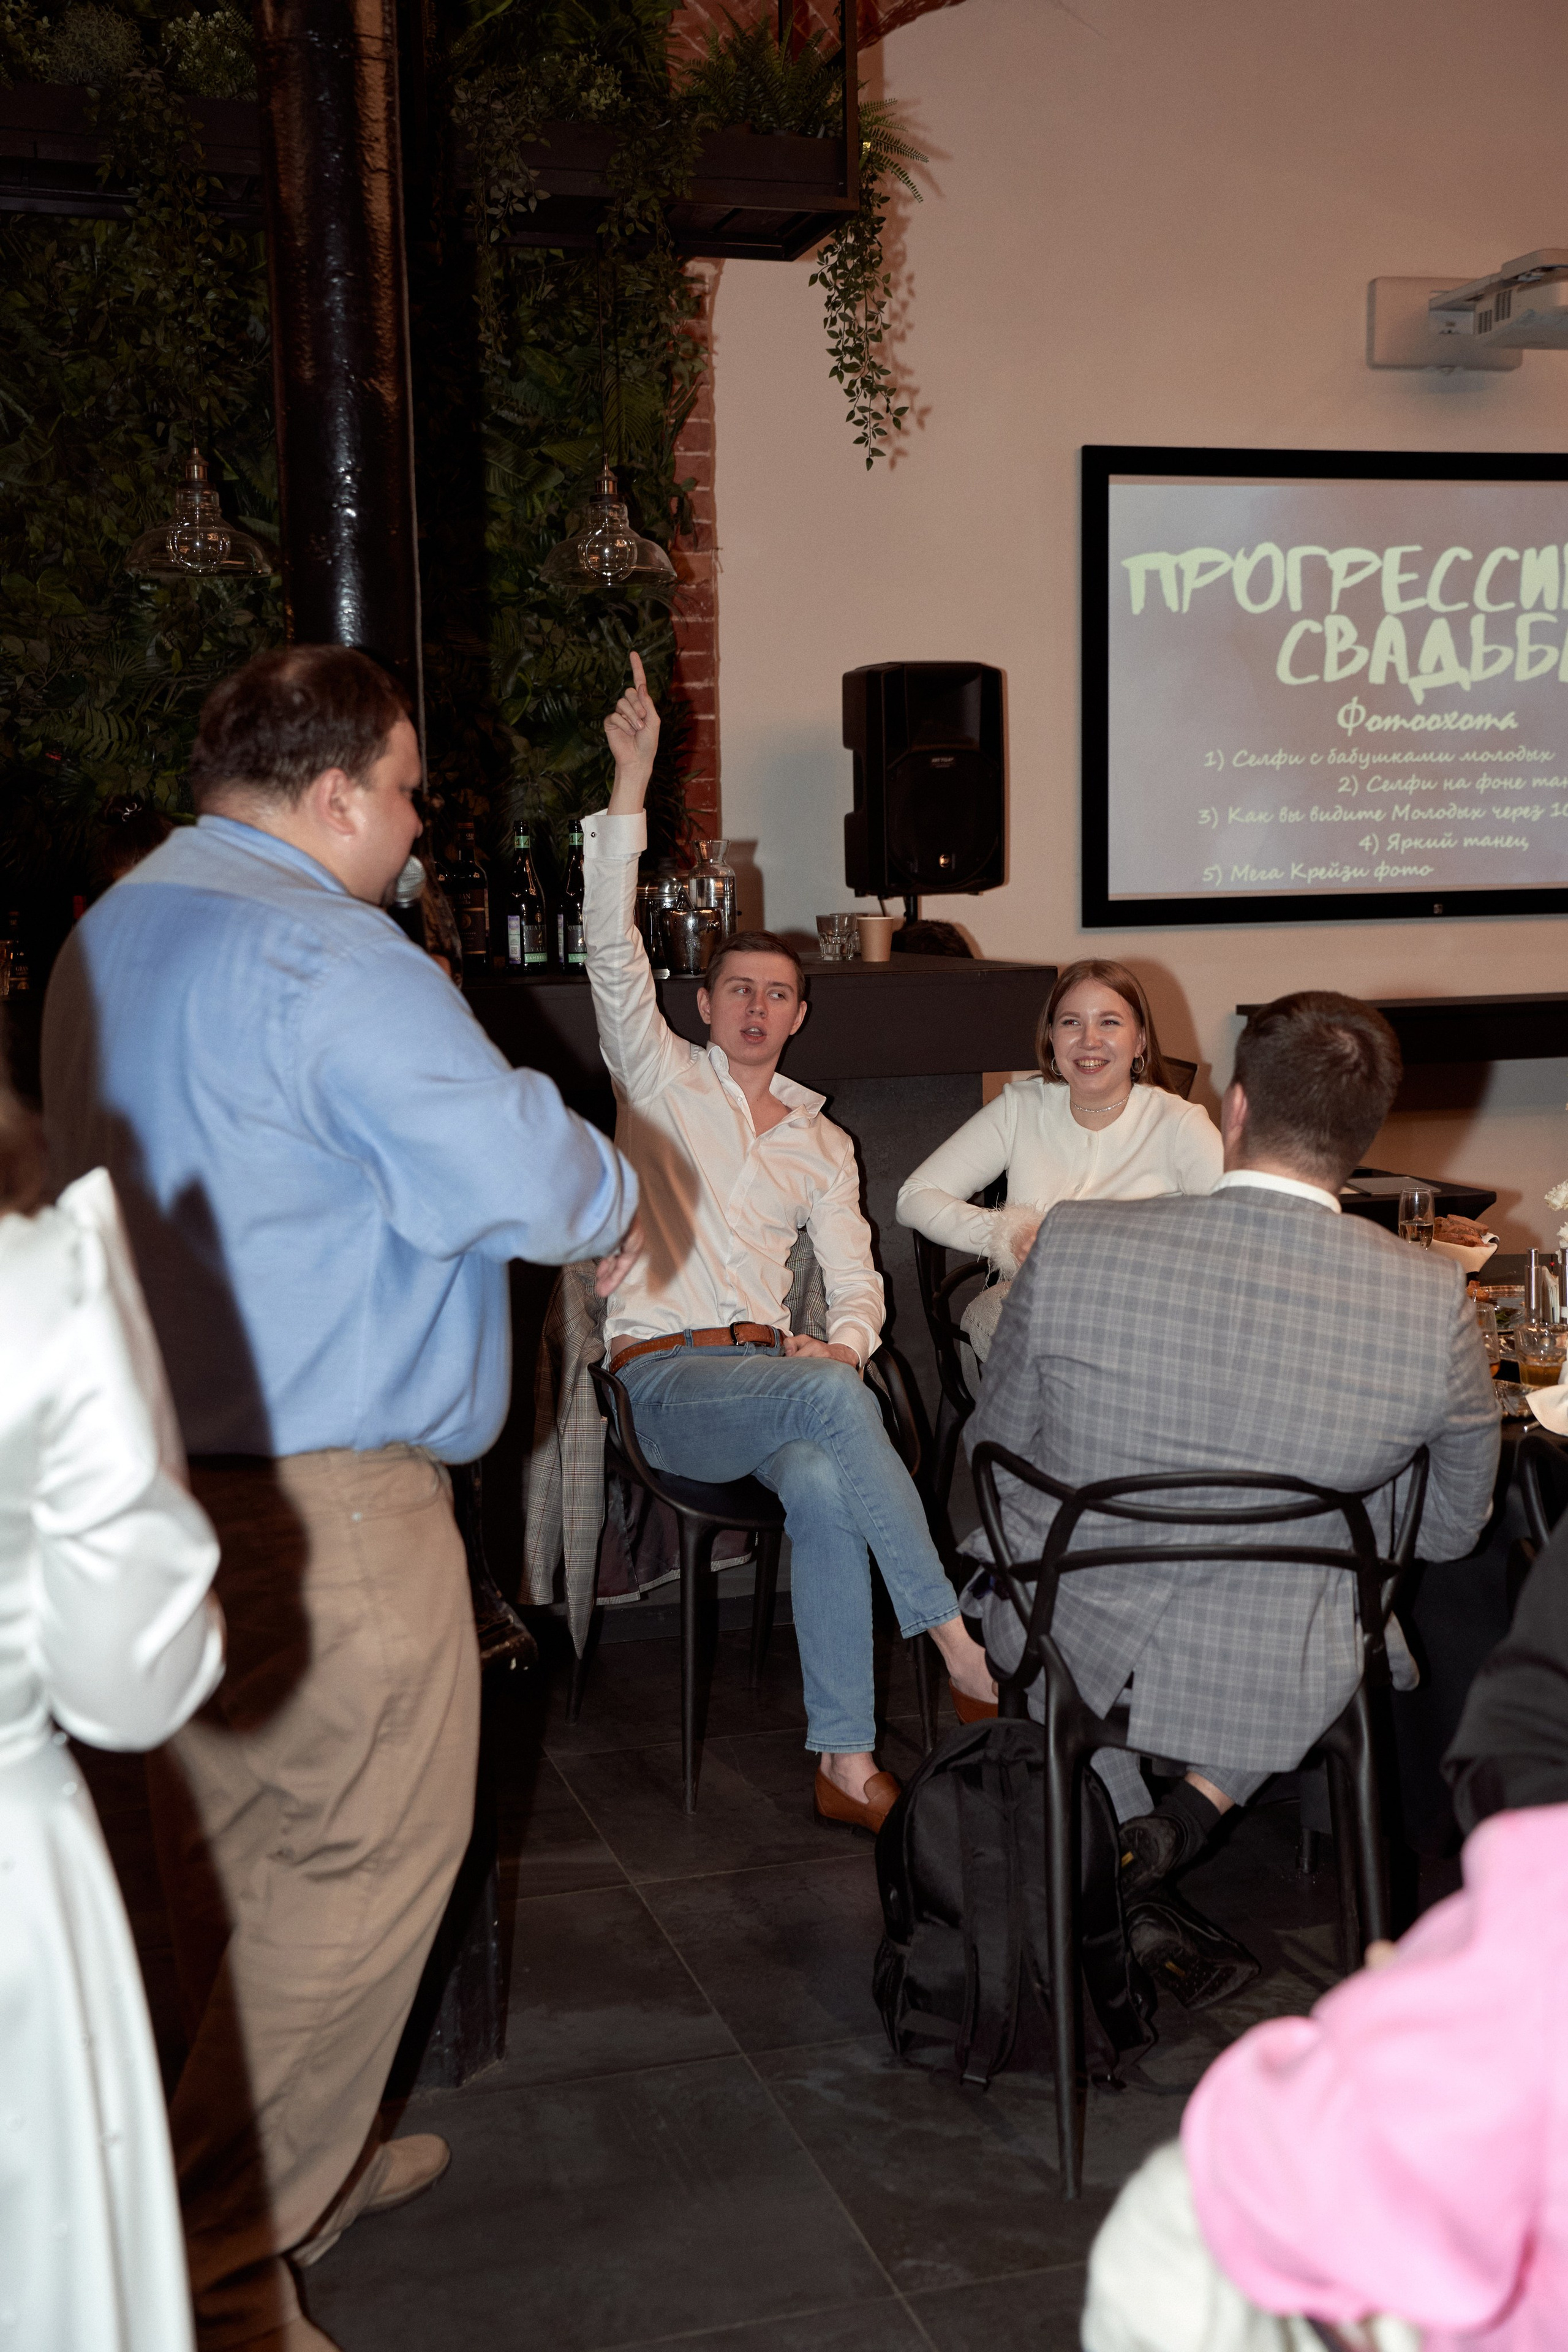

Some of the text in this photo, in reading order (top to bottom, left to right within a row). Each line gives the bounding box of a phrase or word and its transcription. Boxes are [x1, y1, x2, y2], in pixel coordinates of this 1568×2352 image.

[1121, 542, 1568, 614] ПРОГРЕССИ
[1336, 696, 1518, 736] Фотоохота
[1204, 744, 1556, 772] 1) Селфи с бабушками молодых
[1338, 774, 1359, 796] 2)
[1366, 774, 1438, 795] Селфи
[1443, 777, 1471, 791] на
[1476, 772, 1527, 794] фоне
[1197, 807, 1219, 829] 3)
[1228, 806, 1274, 824] Как
[1279, 806, 1306, 823] вы
[1310, 804, 1387, 822] видите
[1391, 802, 1487, 821] Молодых
[1492, 805, 1545, 823] через
[1358, 832, 1529, 855] 4) Яркий танец
[1202, 860, 1434, 886] 5) Мега Крейзи фото
